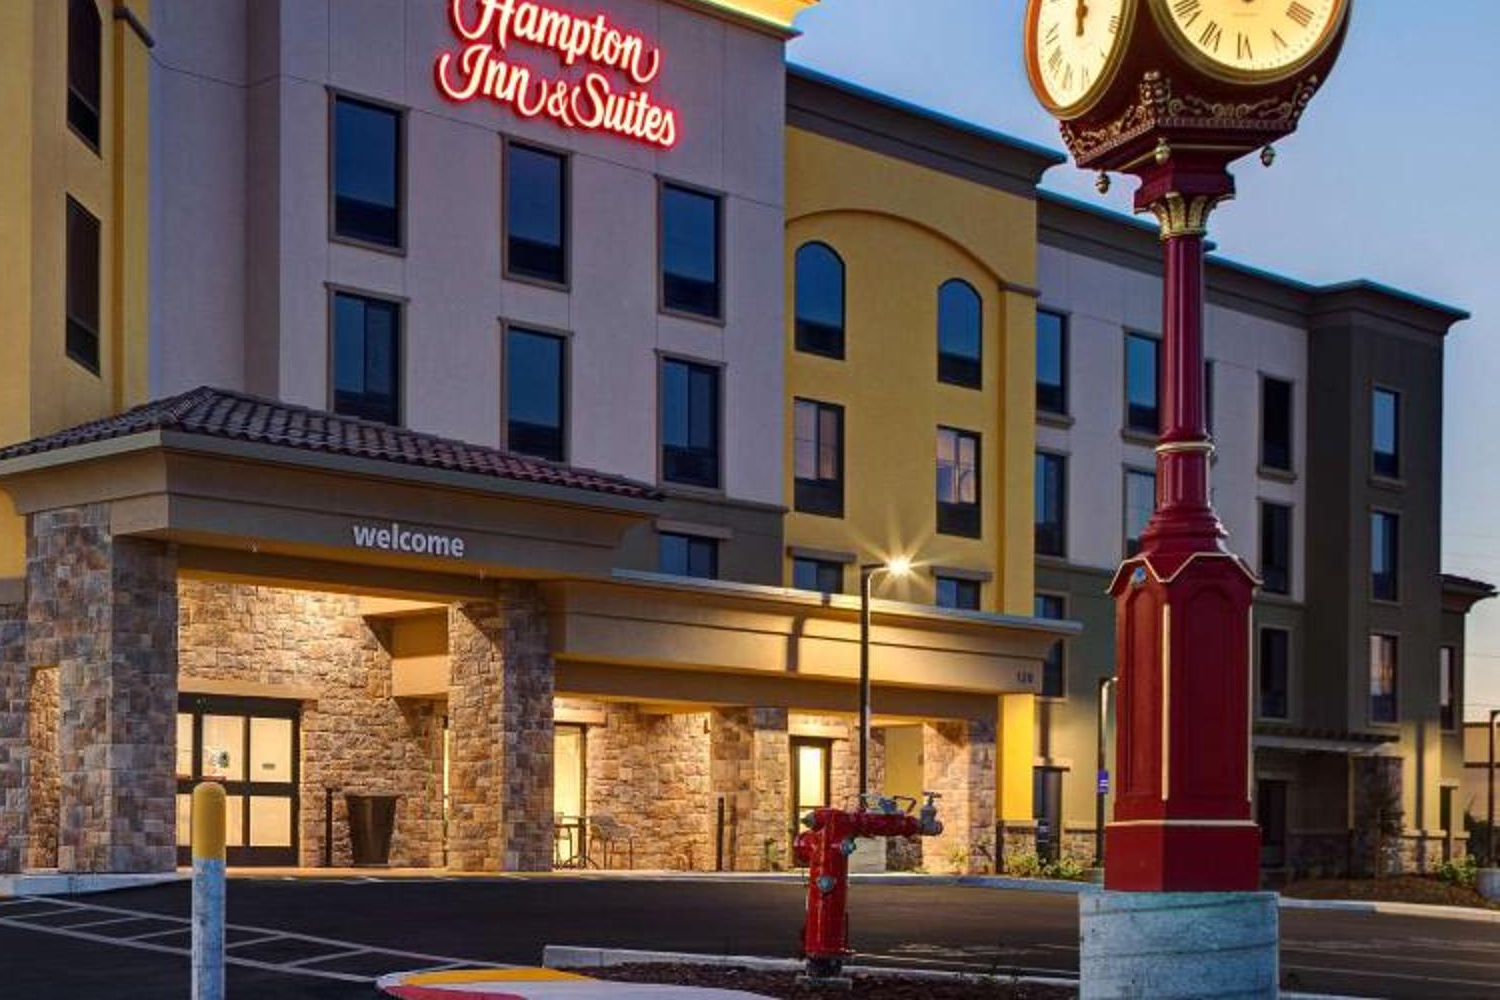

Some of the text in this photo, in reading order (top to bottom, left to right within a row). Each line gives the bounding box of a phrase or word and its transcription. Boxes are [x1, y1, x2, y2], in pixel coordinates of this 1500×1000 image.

[438, 43, 677, 147] Inn & Suites
[352, 521, 466, 558] welcome
